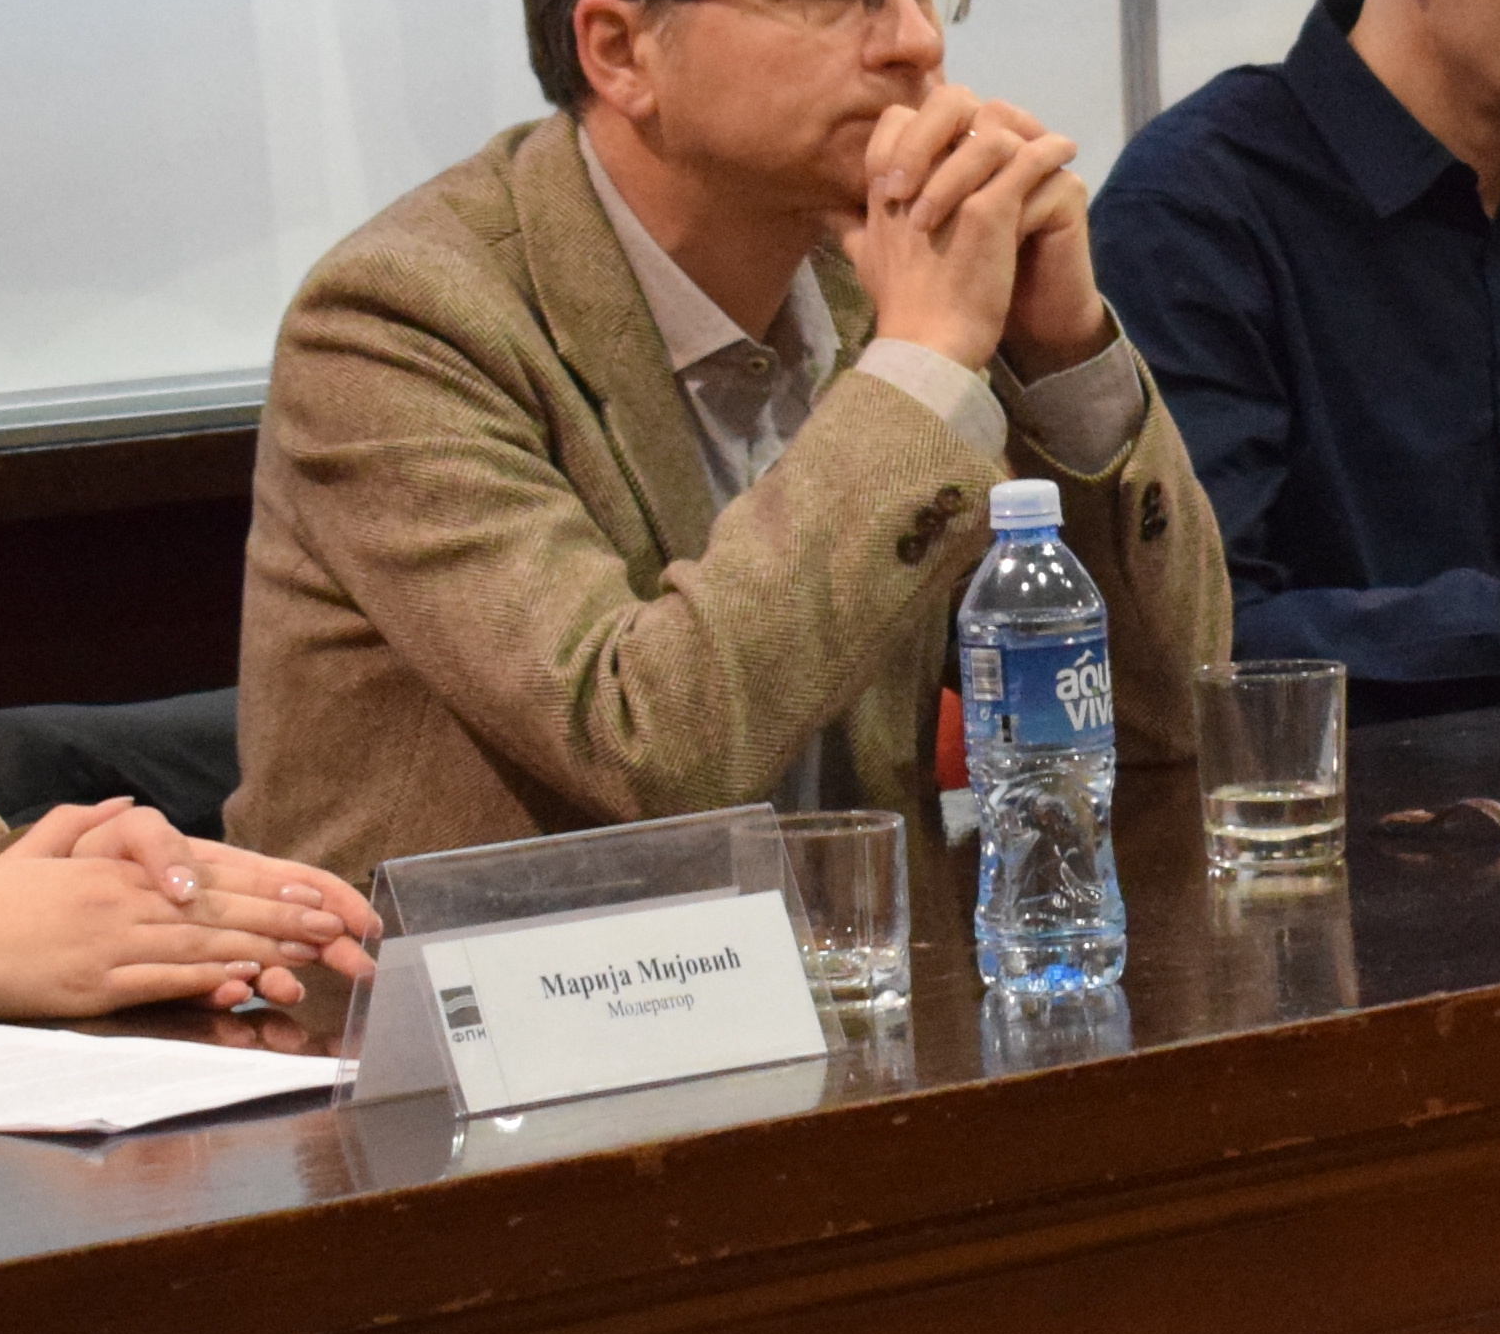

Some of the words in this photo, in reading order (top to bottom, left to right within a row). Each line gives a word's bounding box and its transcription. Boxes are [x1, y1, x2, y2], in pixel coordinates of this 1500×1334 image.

[540, 963, 633, 1000] Марија
[636, 946, 742, 985] Мијовић
[606, 992, 695, 1020] Модератор
[451, 1027, 488, 1044] ФПН
